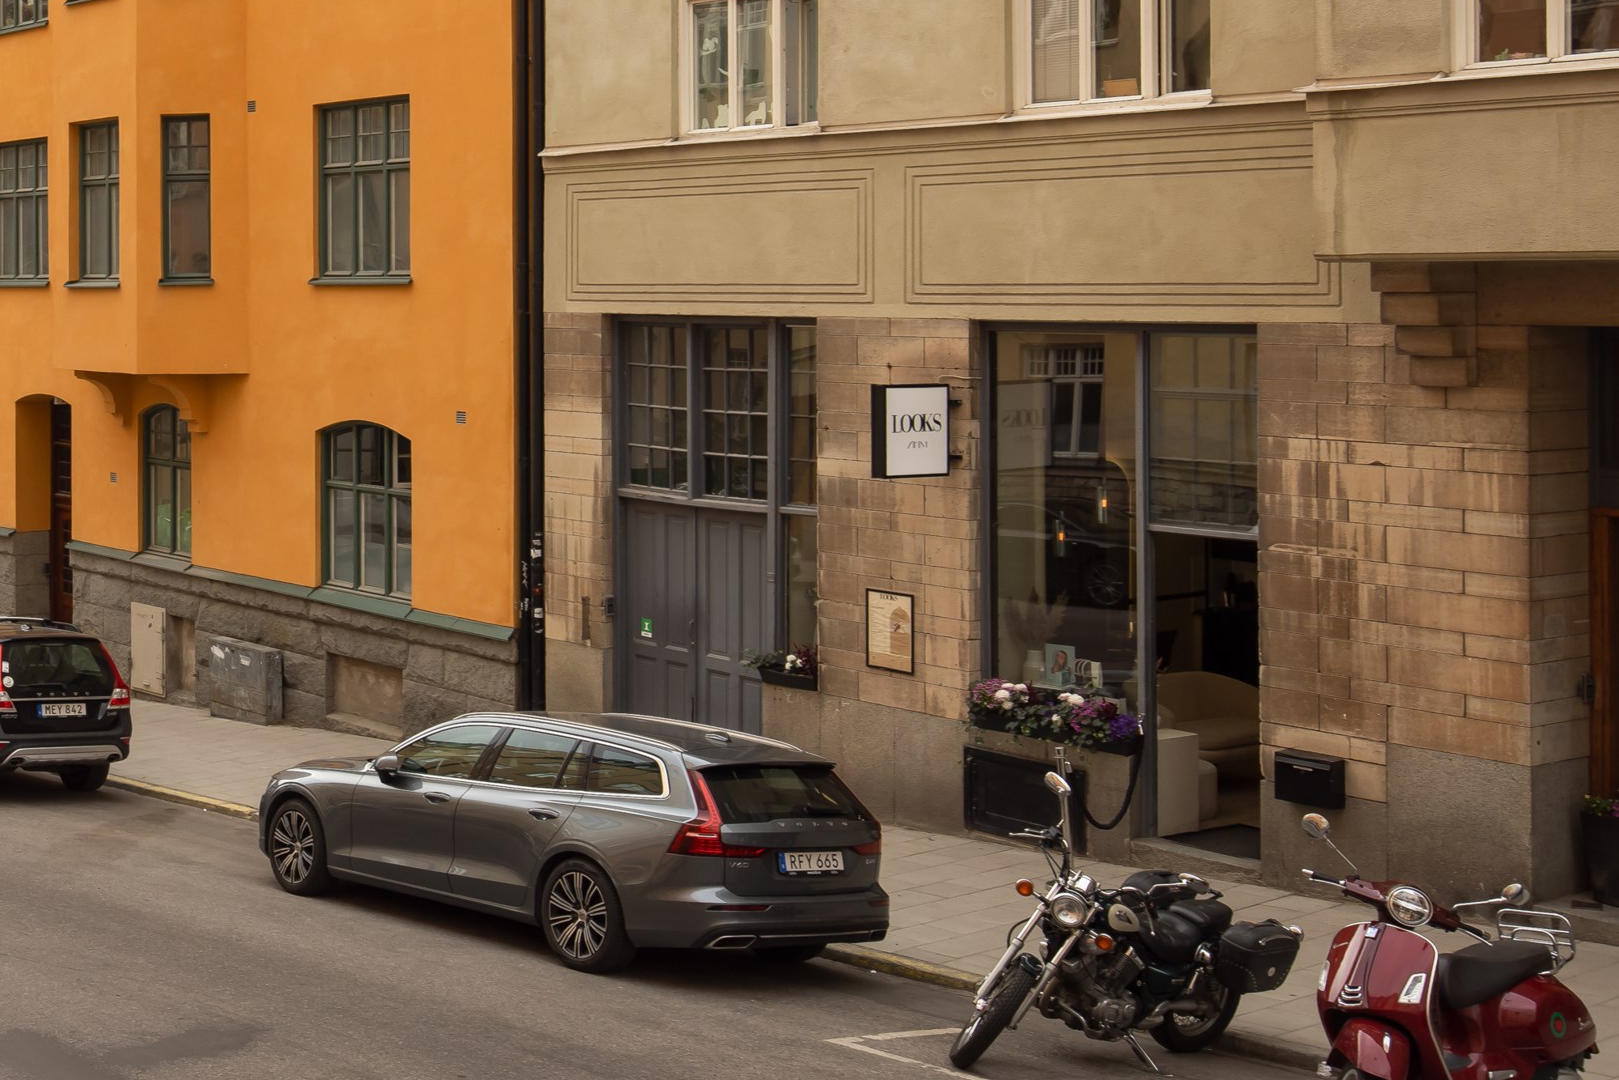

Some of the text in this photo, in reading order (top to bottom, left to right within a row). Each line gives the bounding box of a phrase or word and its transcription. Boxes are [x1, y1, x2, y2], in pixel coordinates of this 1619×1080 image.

[891, 413, 942, 434] LOOKS
[44, 704, 83, 715] MEY 842
[790, 853, 839, 869] RFY 665
